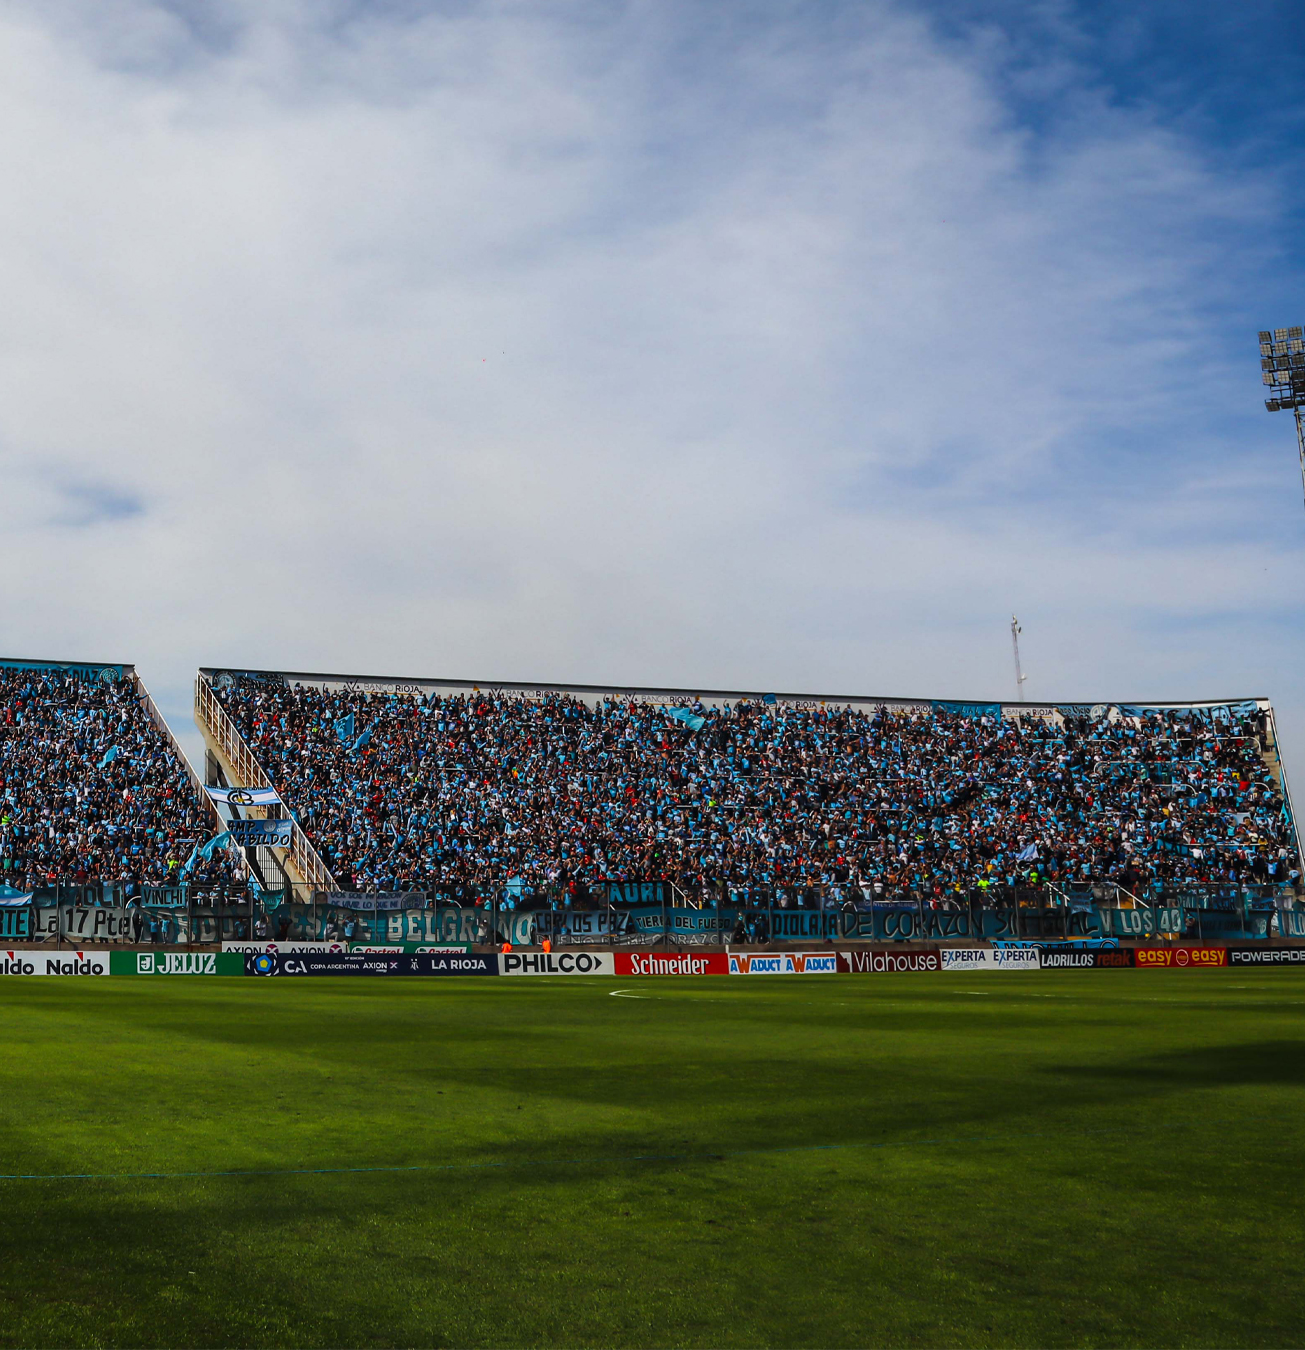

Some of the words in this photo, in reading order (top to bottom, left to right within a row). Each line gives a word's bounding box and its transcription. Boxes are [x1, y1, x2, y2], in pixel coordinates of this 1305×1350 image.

[363, 682, 394, 691] BANCO
[228, 820, 259, 833] AMP.
[330, 891, 346, 899] VOS
[348, 892, 362, 900] SOS
[362, 900, 372, 908] LO
[36, 908, 58, 933] La
[65, 908, 89, 933] 17
[94, 908, 131, 936] Pte
[597, 911, 629, 934] PAZ
[674, 916, 695, 931] DEL
[698, 916, 731, 930] FUEGO
[841, 911, 873, 938] DE
[884, 909, 986, 938] CORAZON
[1120, 911, 1154, 934] LOS
[157, 953, 216, 975] JELUZ
[504, 954, 593, 974] PHILCO
[631, 953, 710, 976] Schneider
[854, 952, 937, 972] Vilahouse
[941, 951, 986, 964] EXPERTA
[993, 951, 1037, 964] EXPERTA
[1041, 954, 1094, 967] LADRILLOS
[1097, 949, 1132, 967] retak
[1138, 950, 1172, 965] easy
[1191, 949, 1225, 965] easy
[1231, 950, 1305, 963] POWERADE
[46, 958, 104, 976] Naldo
[362, 962, 388, 970] AXION
[431, 959, 447, 970] LA
[450, 959, 487, 971] RIOJA
